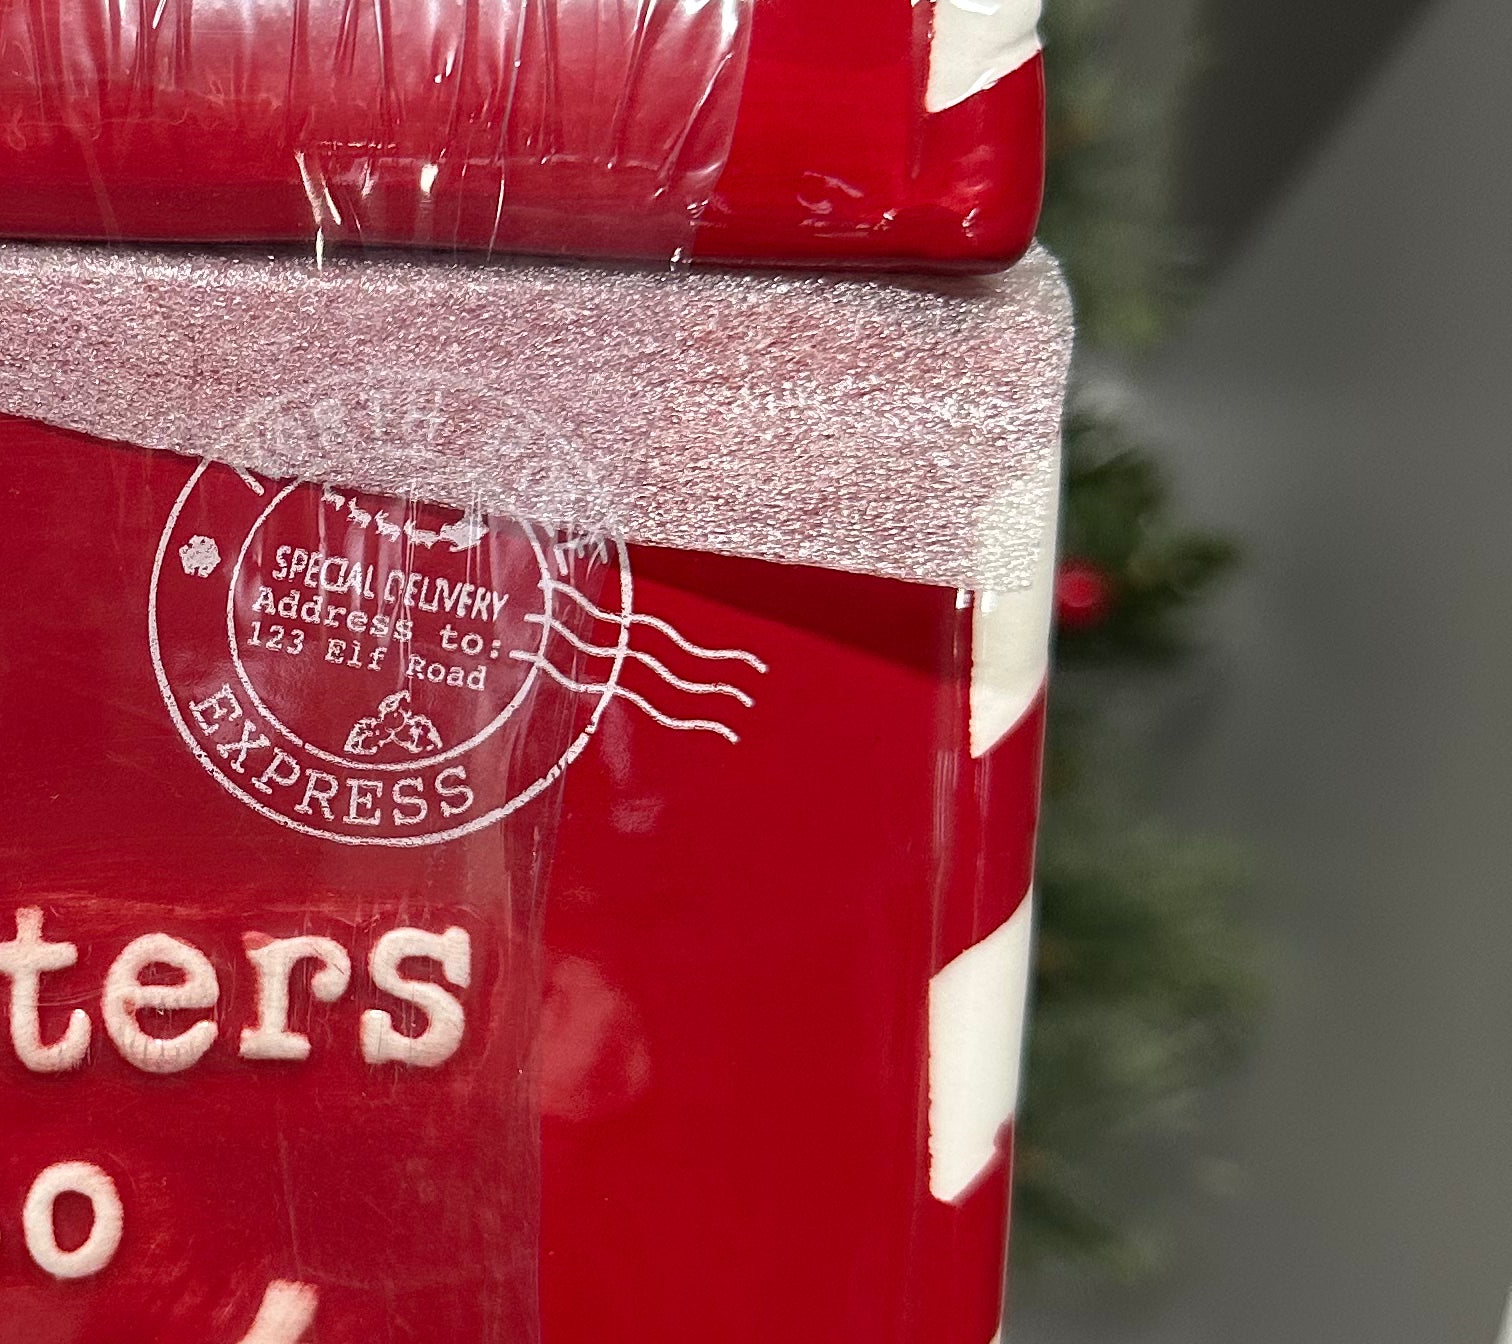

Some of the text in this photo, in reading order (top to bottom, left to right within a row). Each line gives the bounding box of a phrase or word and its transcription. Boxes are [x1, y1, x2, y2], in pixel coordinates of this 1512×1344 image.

[272, 545, 509, 622] SPECIAL DELIVERY
[246, 621, 487, 691] 123 Elf Road
[251, 586, 502, 659] Address to:
[189, 683, 475, 826] EXPRESS
